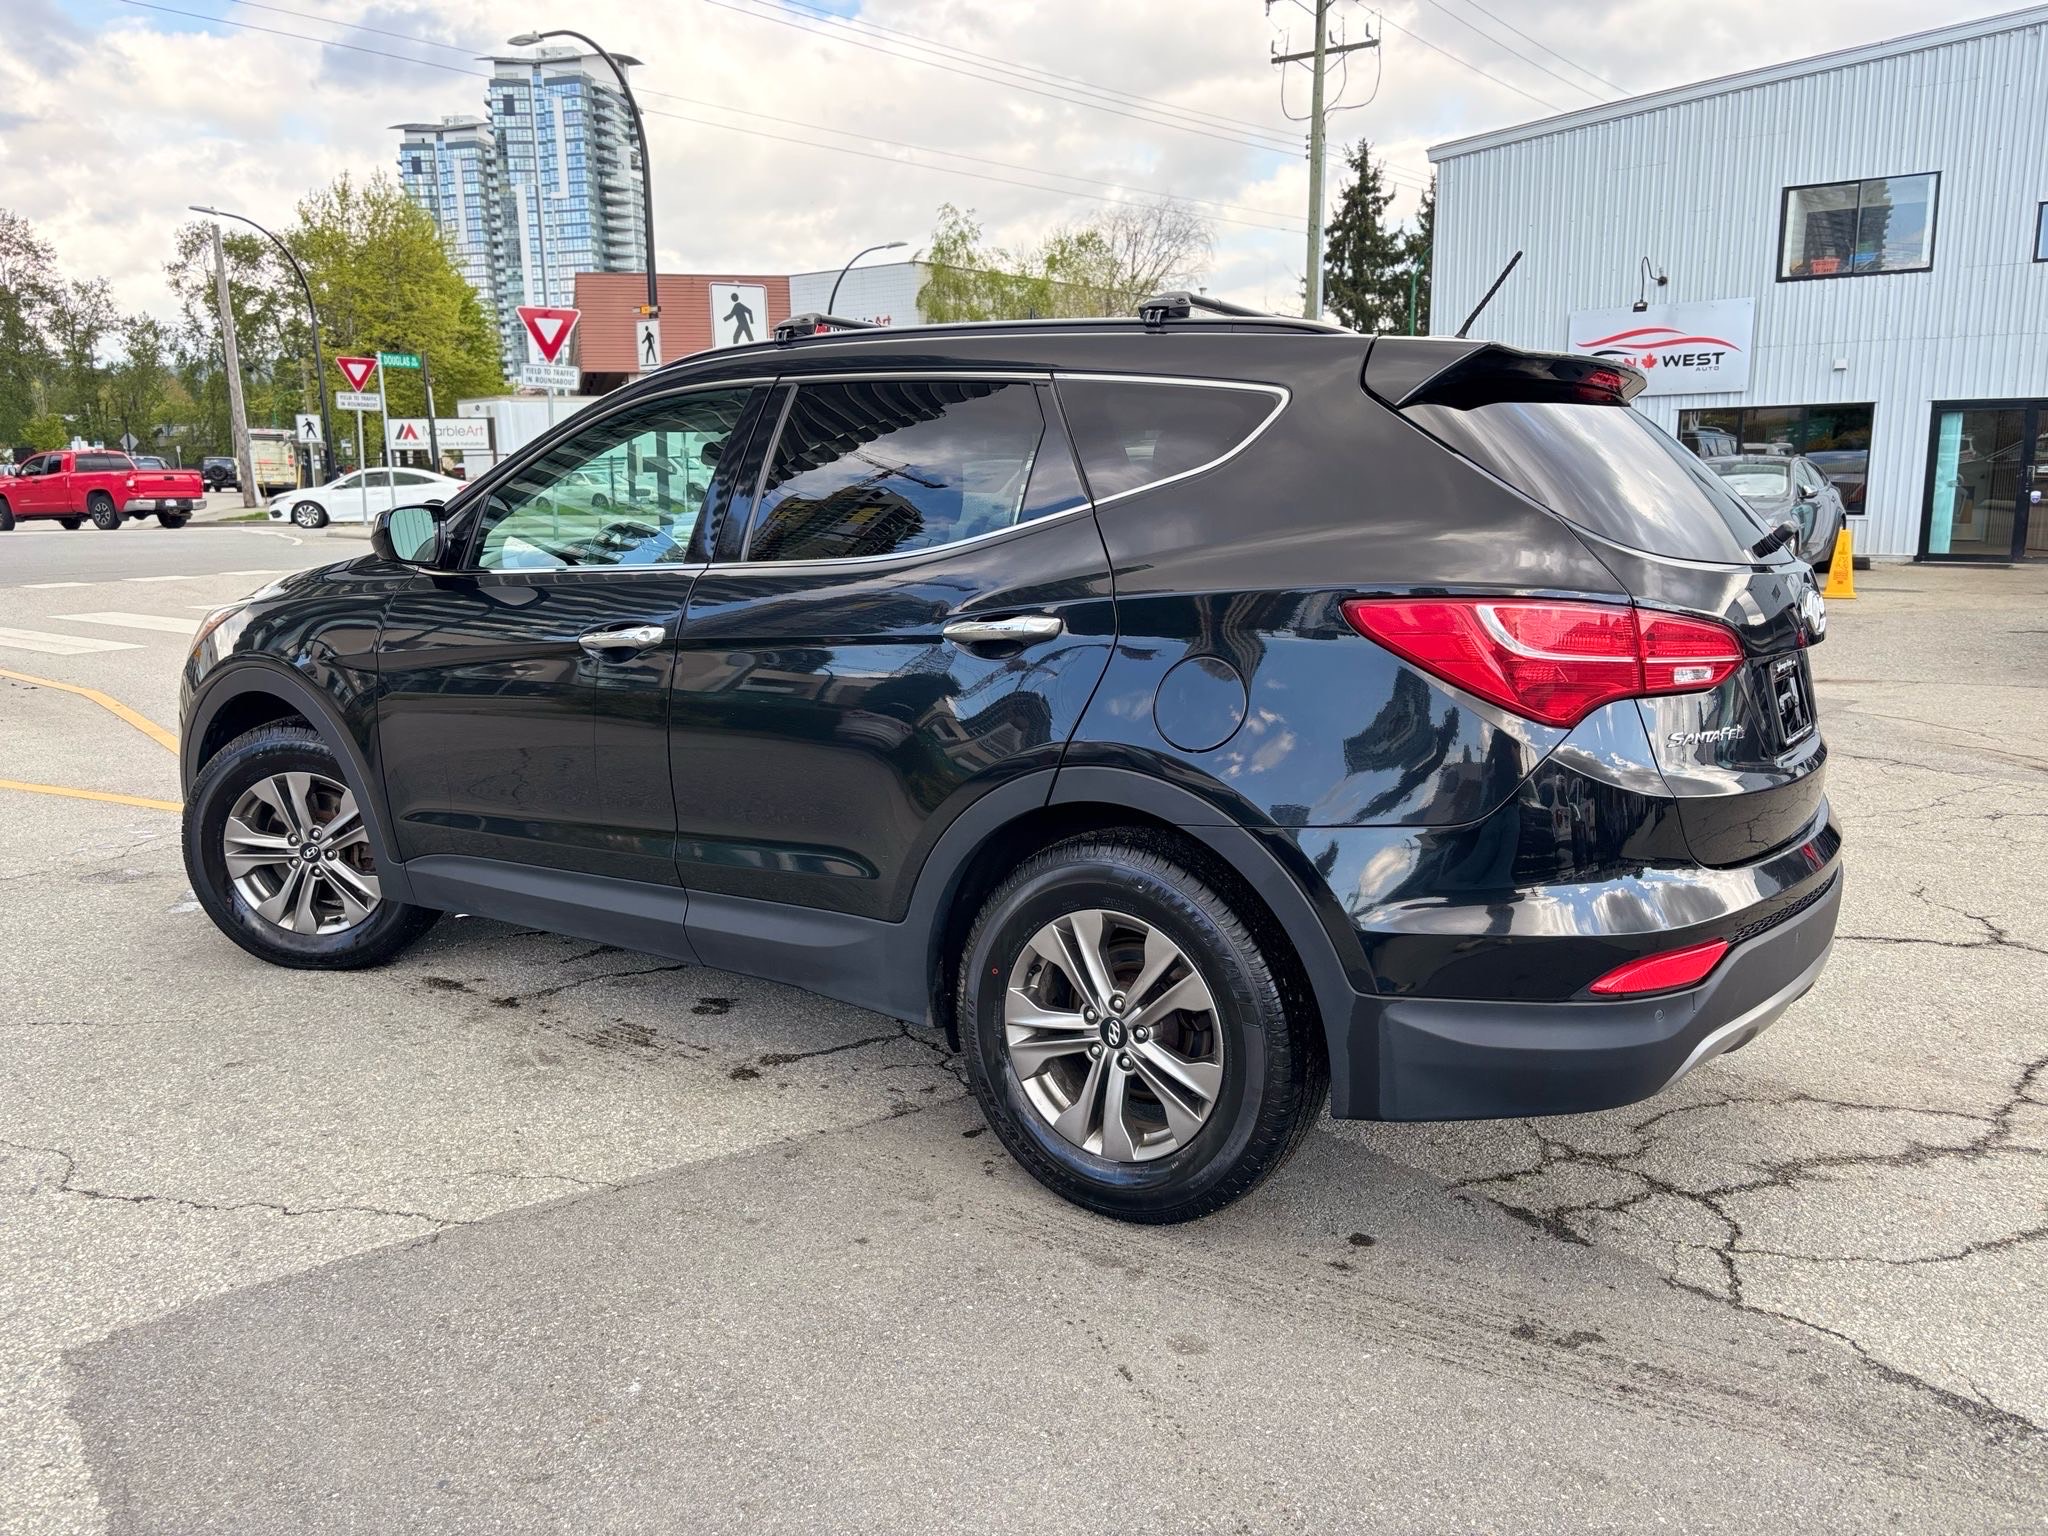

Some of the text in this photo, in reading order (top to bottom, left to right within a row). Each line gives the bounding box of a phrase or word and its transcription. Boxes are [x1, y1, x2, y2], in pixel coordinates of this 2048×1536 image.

[383, 355, 411, 367] DOUGLAS
[1662, 351, 1726, 368] WEST
[525, 367, 542, 375] YIELD
[553, 369, 576, 378] TRAFFIC
[535, 376, 575, 386] ROUNDABOUT
